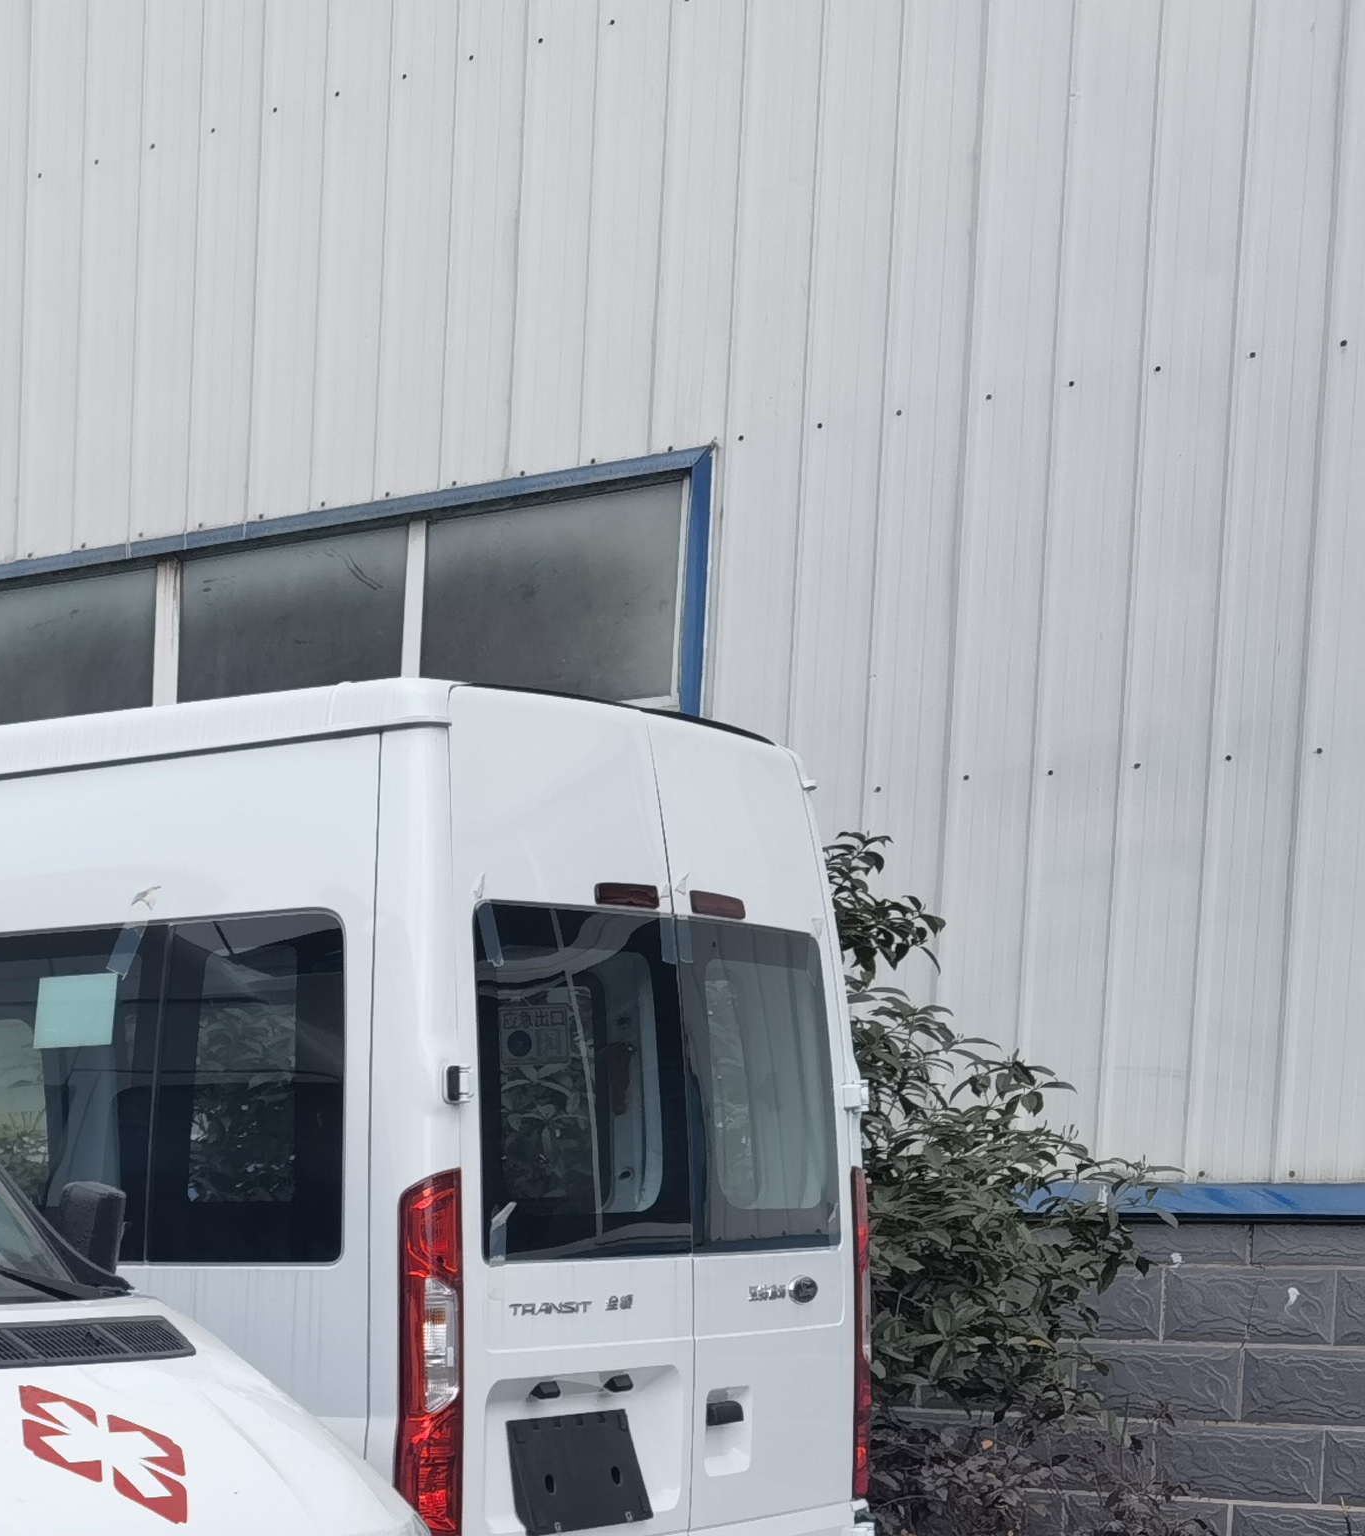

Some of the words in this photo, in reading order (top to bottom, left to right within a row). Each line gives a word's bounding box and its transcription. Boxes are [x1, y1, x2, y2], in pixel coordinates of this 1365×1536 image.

[503, 1010, 566, 1029] 应急出口
[509, 1301, 592, 1316] TRANSIT
